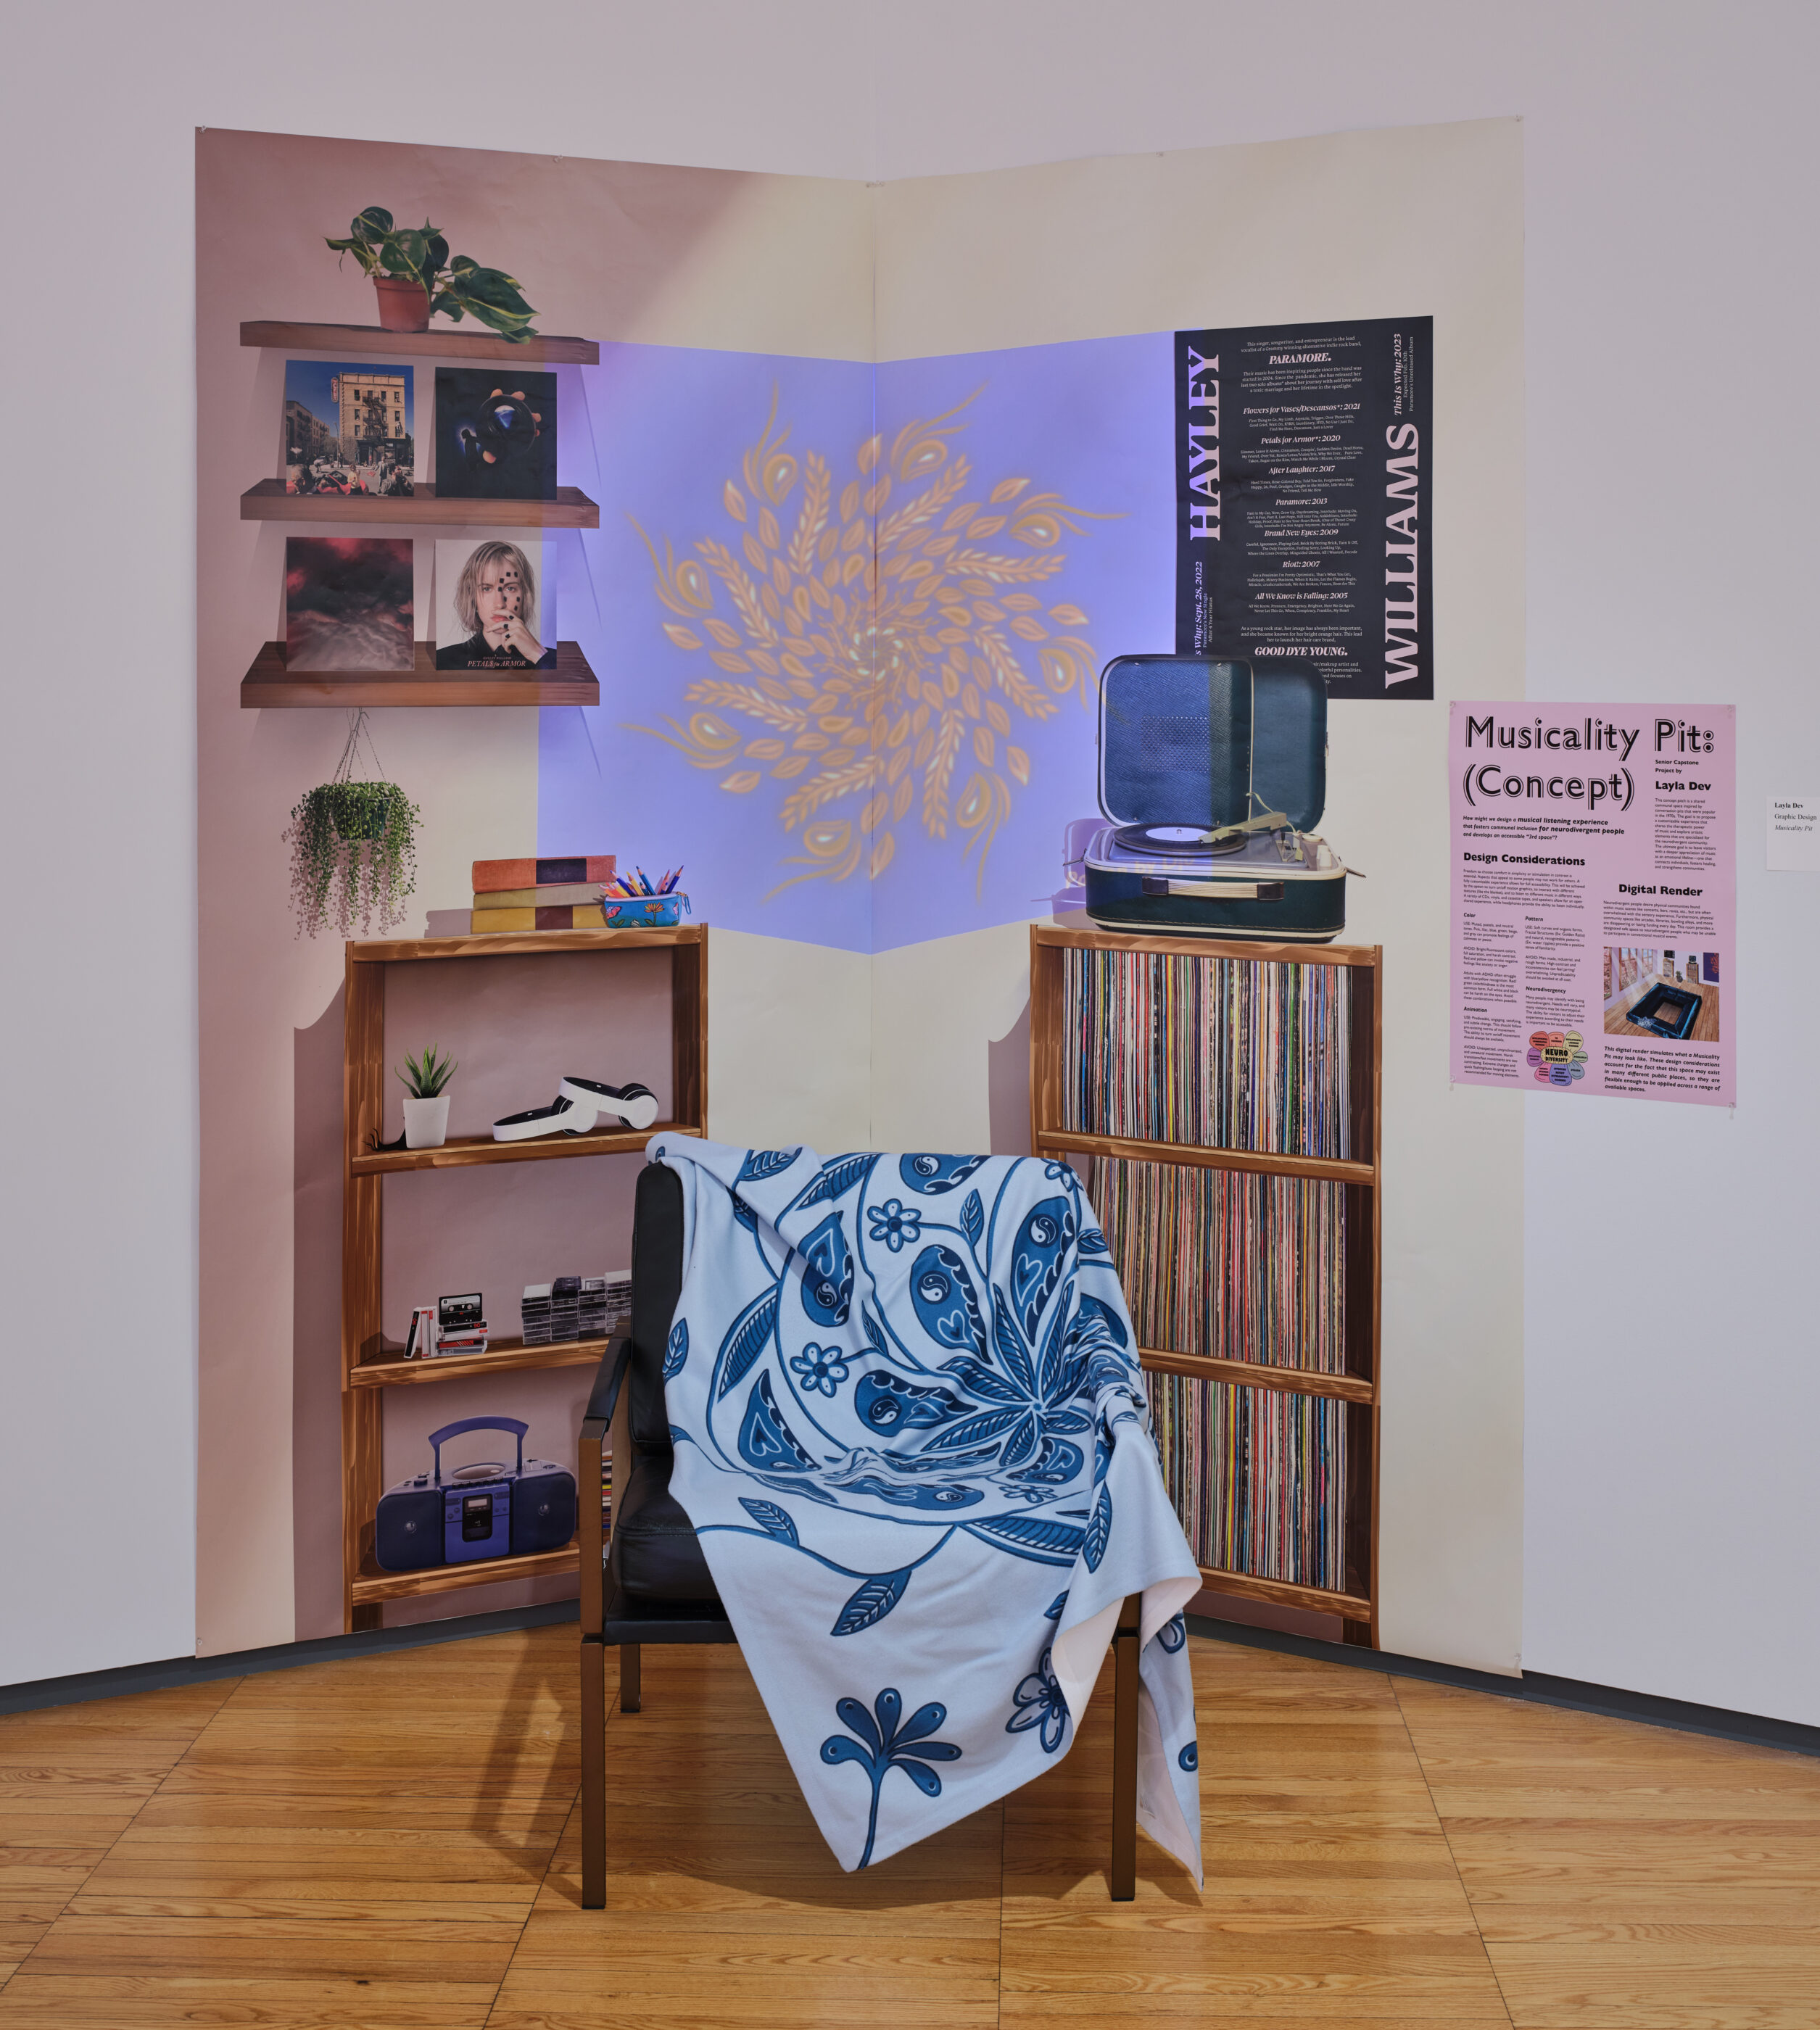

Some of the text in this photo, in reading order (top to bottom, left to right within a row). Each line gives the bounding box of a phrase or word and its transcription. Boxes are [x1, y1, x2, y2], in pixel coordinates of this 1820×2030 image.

[1269, 352, 1332, 365] PARAMORE.
[1393, 358, 1402, 384] Why:
[1394, 385, 1402, 394] Is
[1269, 406, 1280, 415] for
[1393, 395, 1402, 415] This
[1188, 346, 1221, 542] HAYLEY
[1281, 436, 1292, 444] for
[1268, 466, 1285, 475] After
[1286, 465, 1318, 474] Laughter:
[1384, 423, 1419, 689] WILLIAMS
[1303, 592, 1329, 600] Falling:
[1194, 602, 1204, 624] Sept.
[1194, 624, 1204, 648] Why:
[1254, 647, 1348, 655] GOOD DYE YOUNG.
[1465, 716, 1714, 761] Musicality Pit:
[1463, 763, 1635, 811] (Concept)
[1655, 780, 1711, 792] Layla Dev
[1543, 817, 1571, 826] listening
[1463, 852, 1585, 866] Design Considerations
[1618, 884, 1703, 896] Digital Render
[1525, 985, 1566, 994] Neurodivergency
[1545, 1048, 1568, 1057] NEURO
